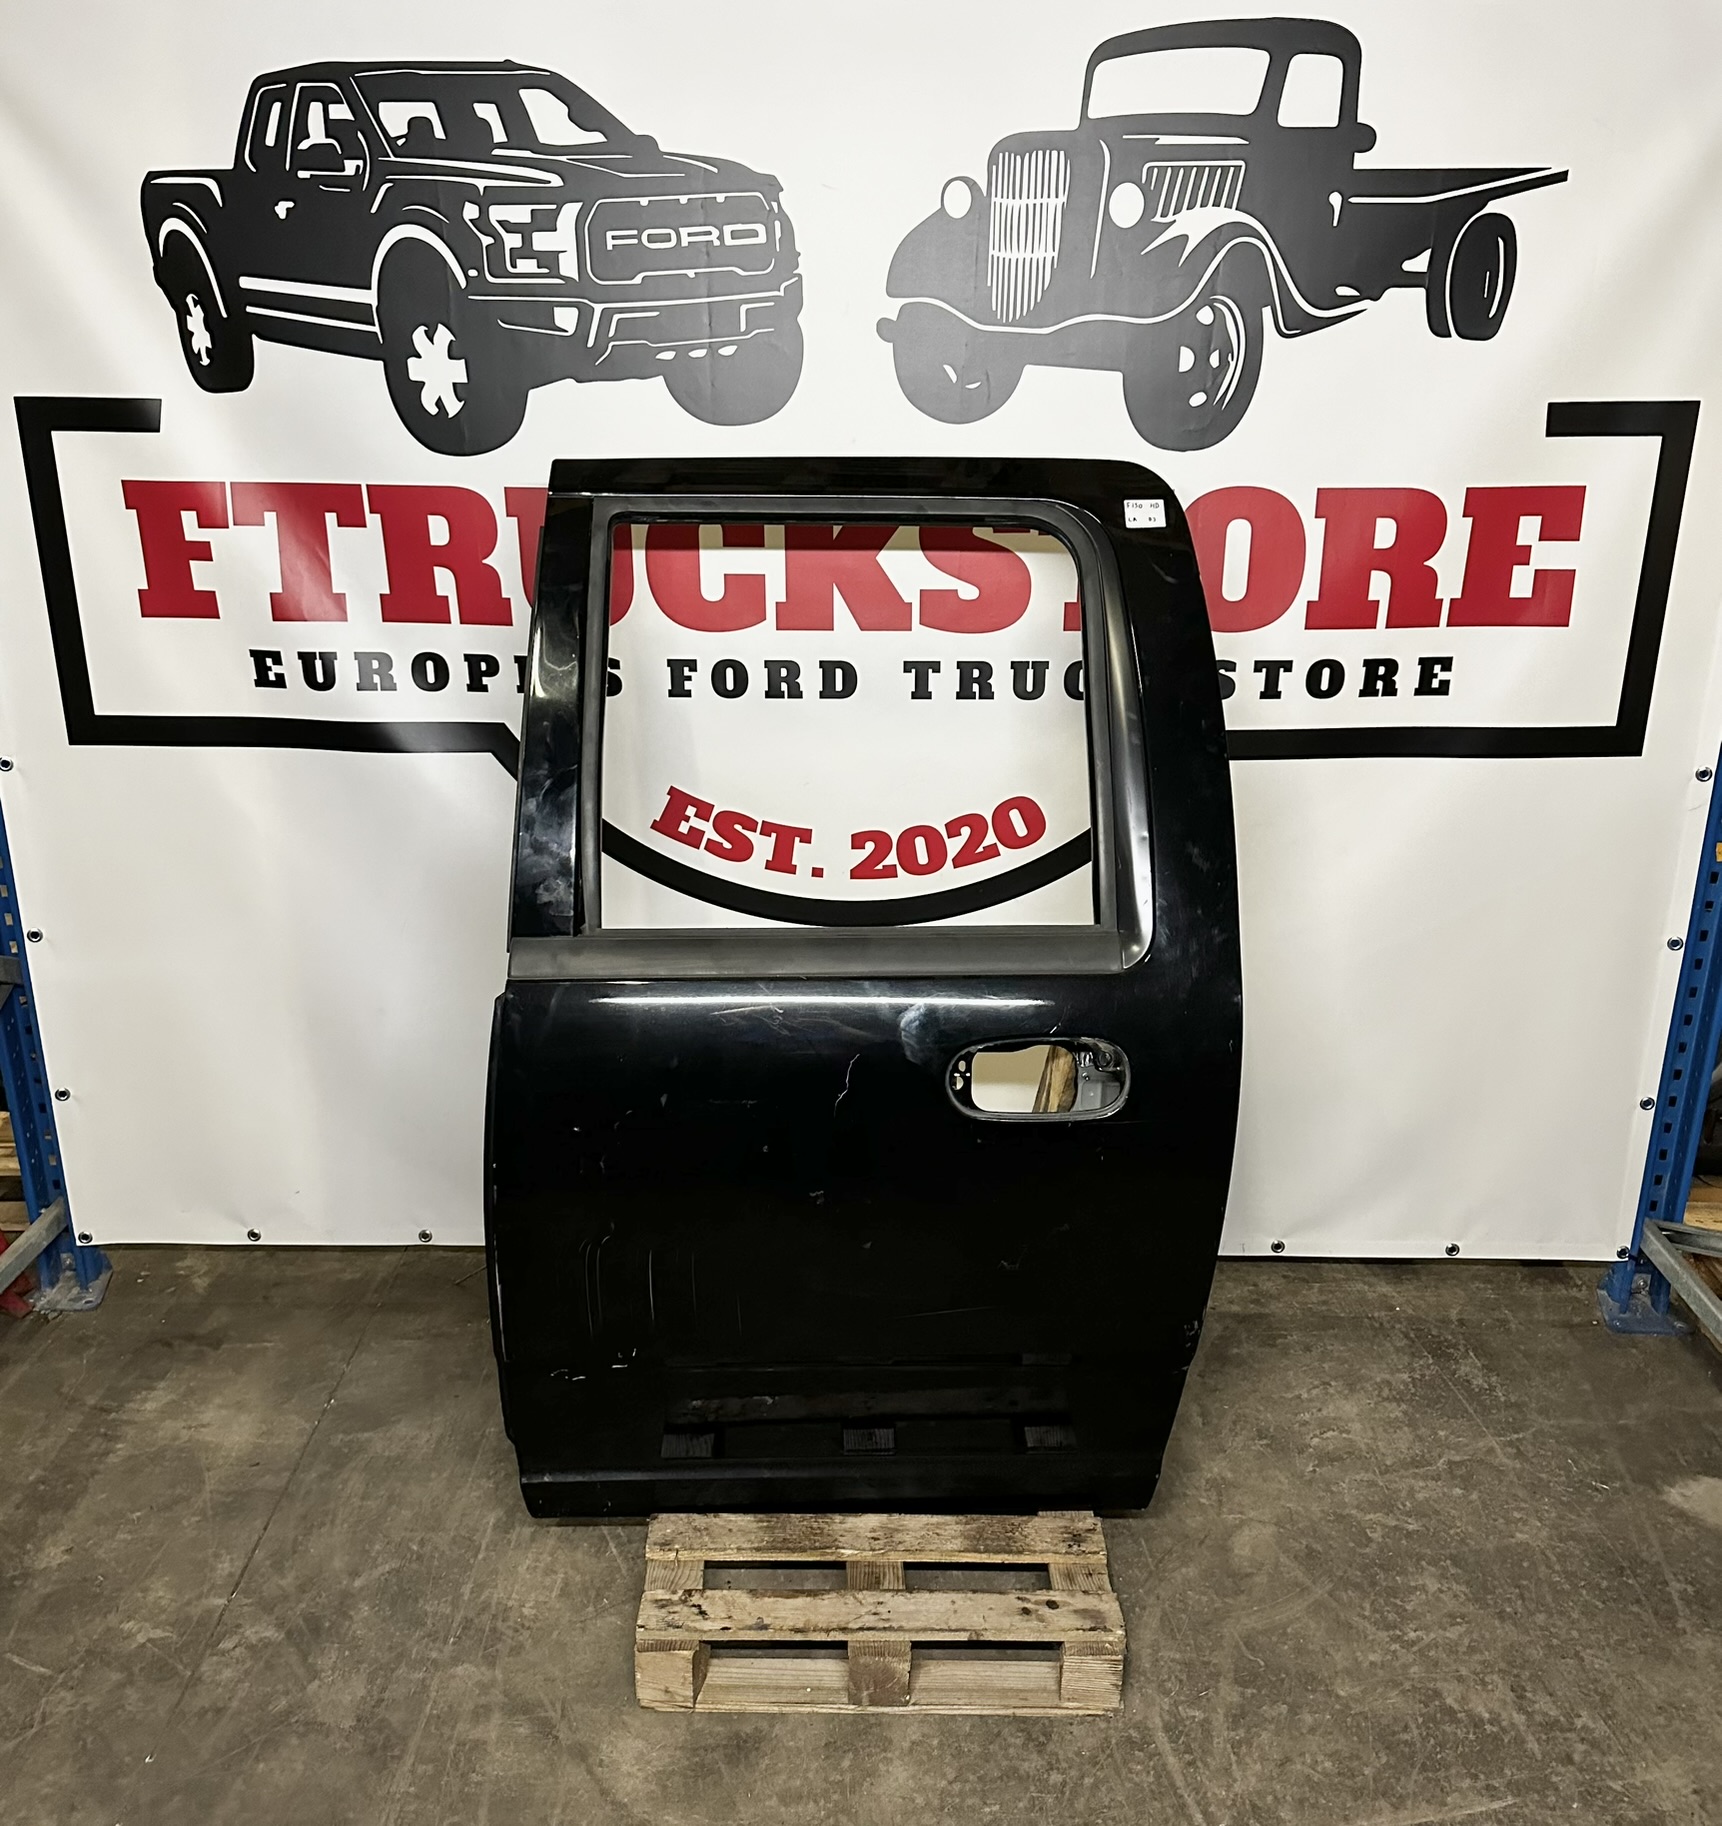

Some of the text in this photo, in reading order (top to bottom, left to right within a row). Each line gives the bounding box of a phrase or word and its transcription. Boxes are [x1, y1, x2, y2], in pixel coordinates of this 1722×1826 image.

[605, 223, 767, 251] FORD
[122, 480, 1587, 634] FTRUCKSORE
[666, 658, 858, 700] FORD
[903, 660, 1084, 701] TRUC
[1215, 656, 1454, 700] STORE
[650, 785, 1047, 880] EST. 2020
